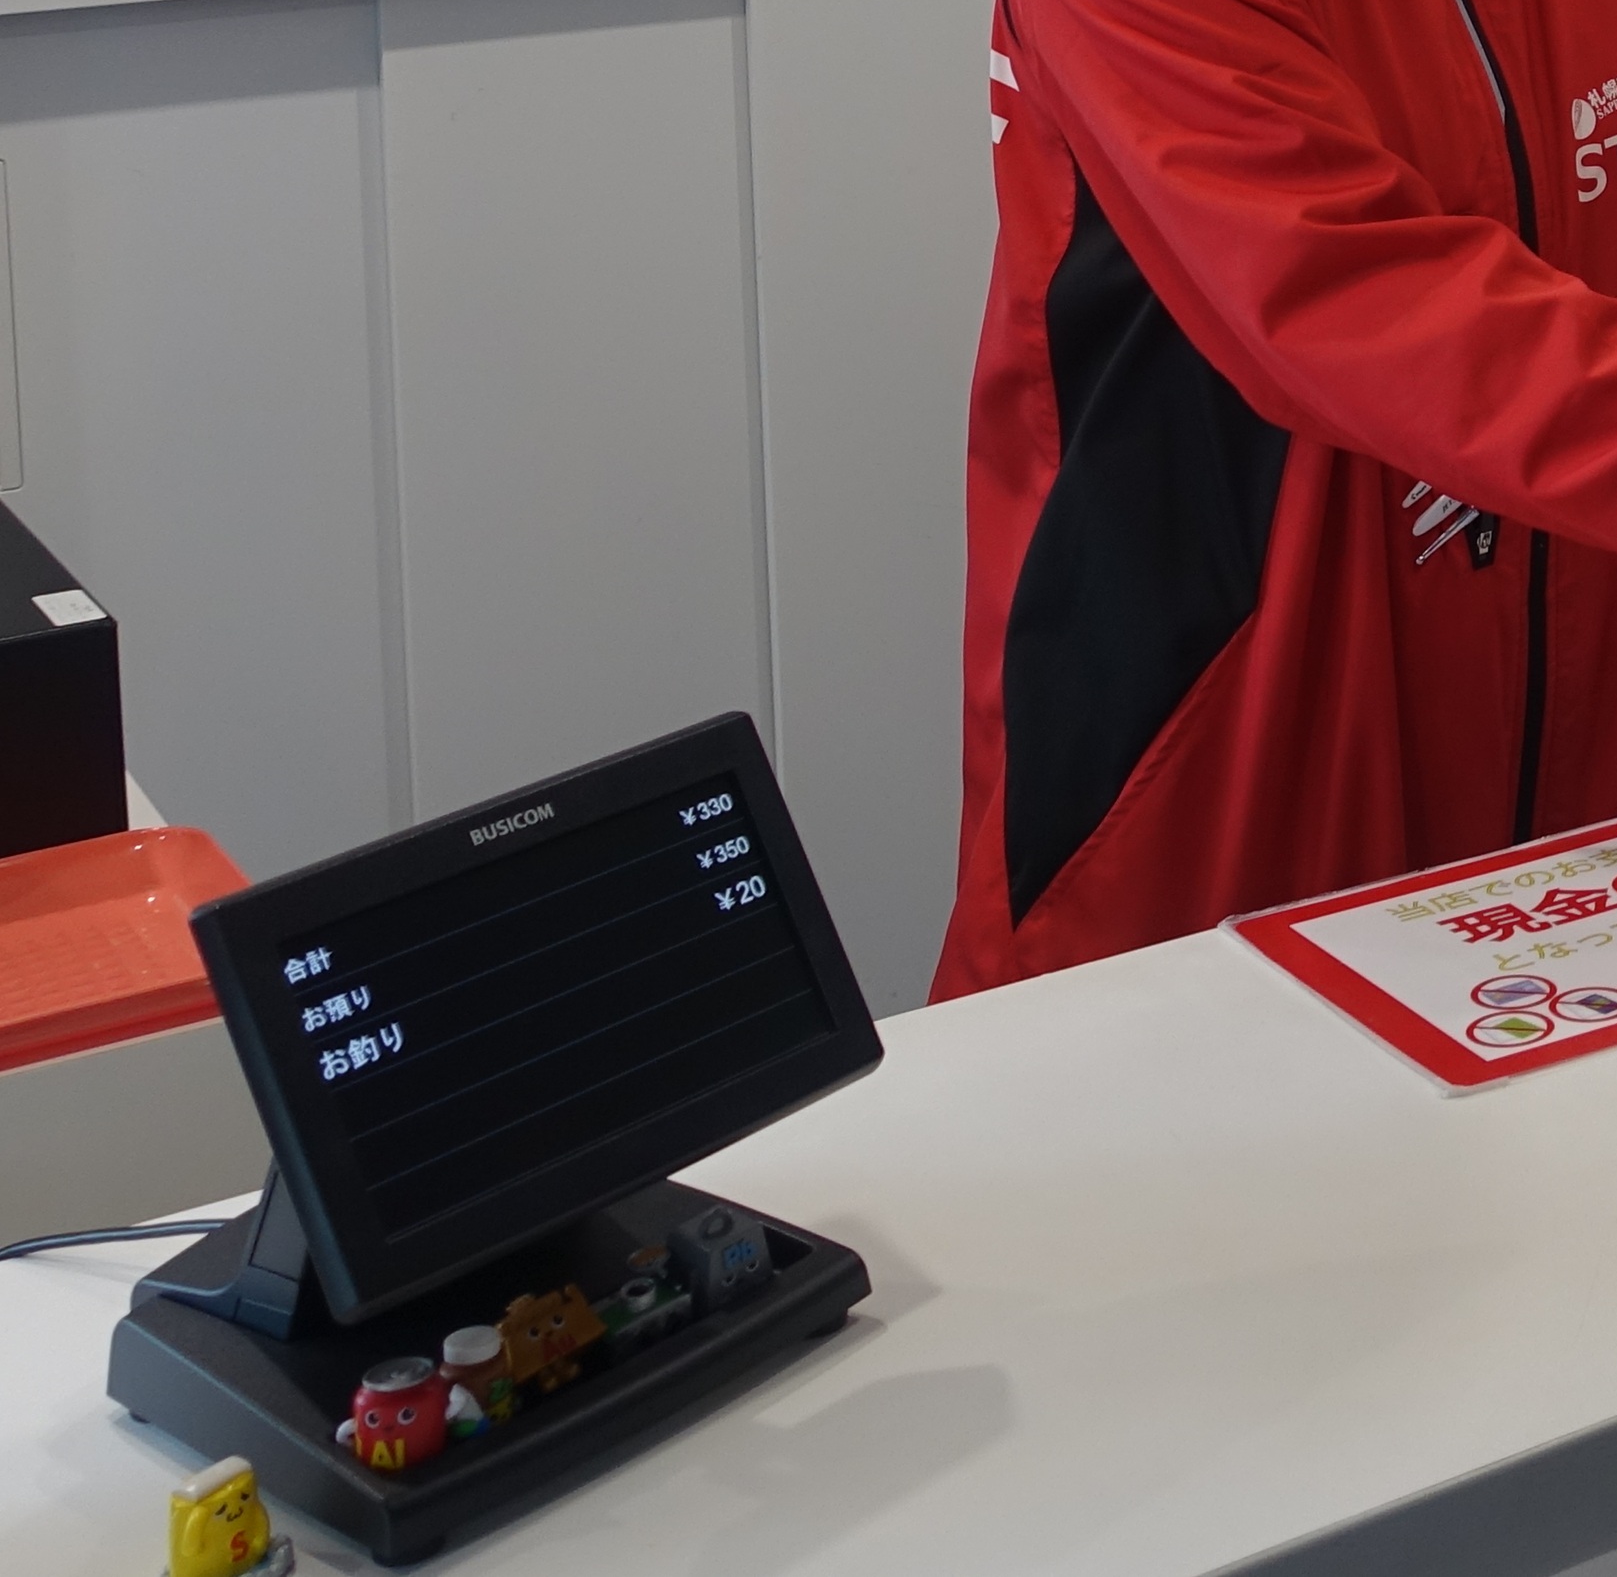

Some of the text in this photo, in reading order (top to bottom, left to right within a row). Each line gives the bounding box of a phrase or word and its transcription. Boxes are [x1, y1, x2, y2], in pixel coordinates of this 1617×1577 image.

[283, 792, 735, 985] 合計 ¥330
[468, 802, 556, 848] BUSICOM
[301, 835, 751, 1034] お預り ¥350
[318, 874, 768, 1082] お釣り ¥20
[229, 1531, 250, 1564] S
